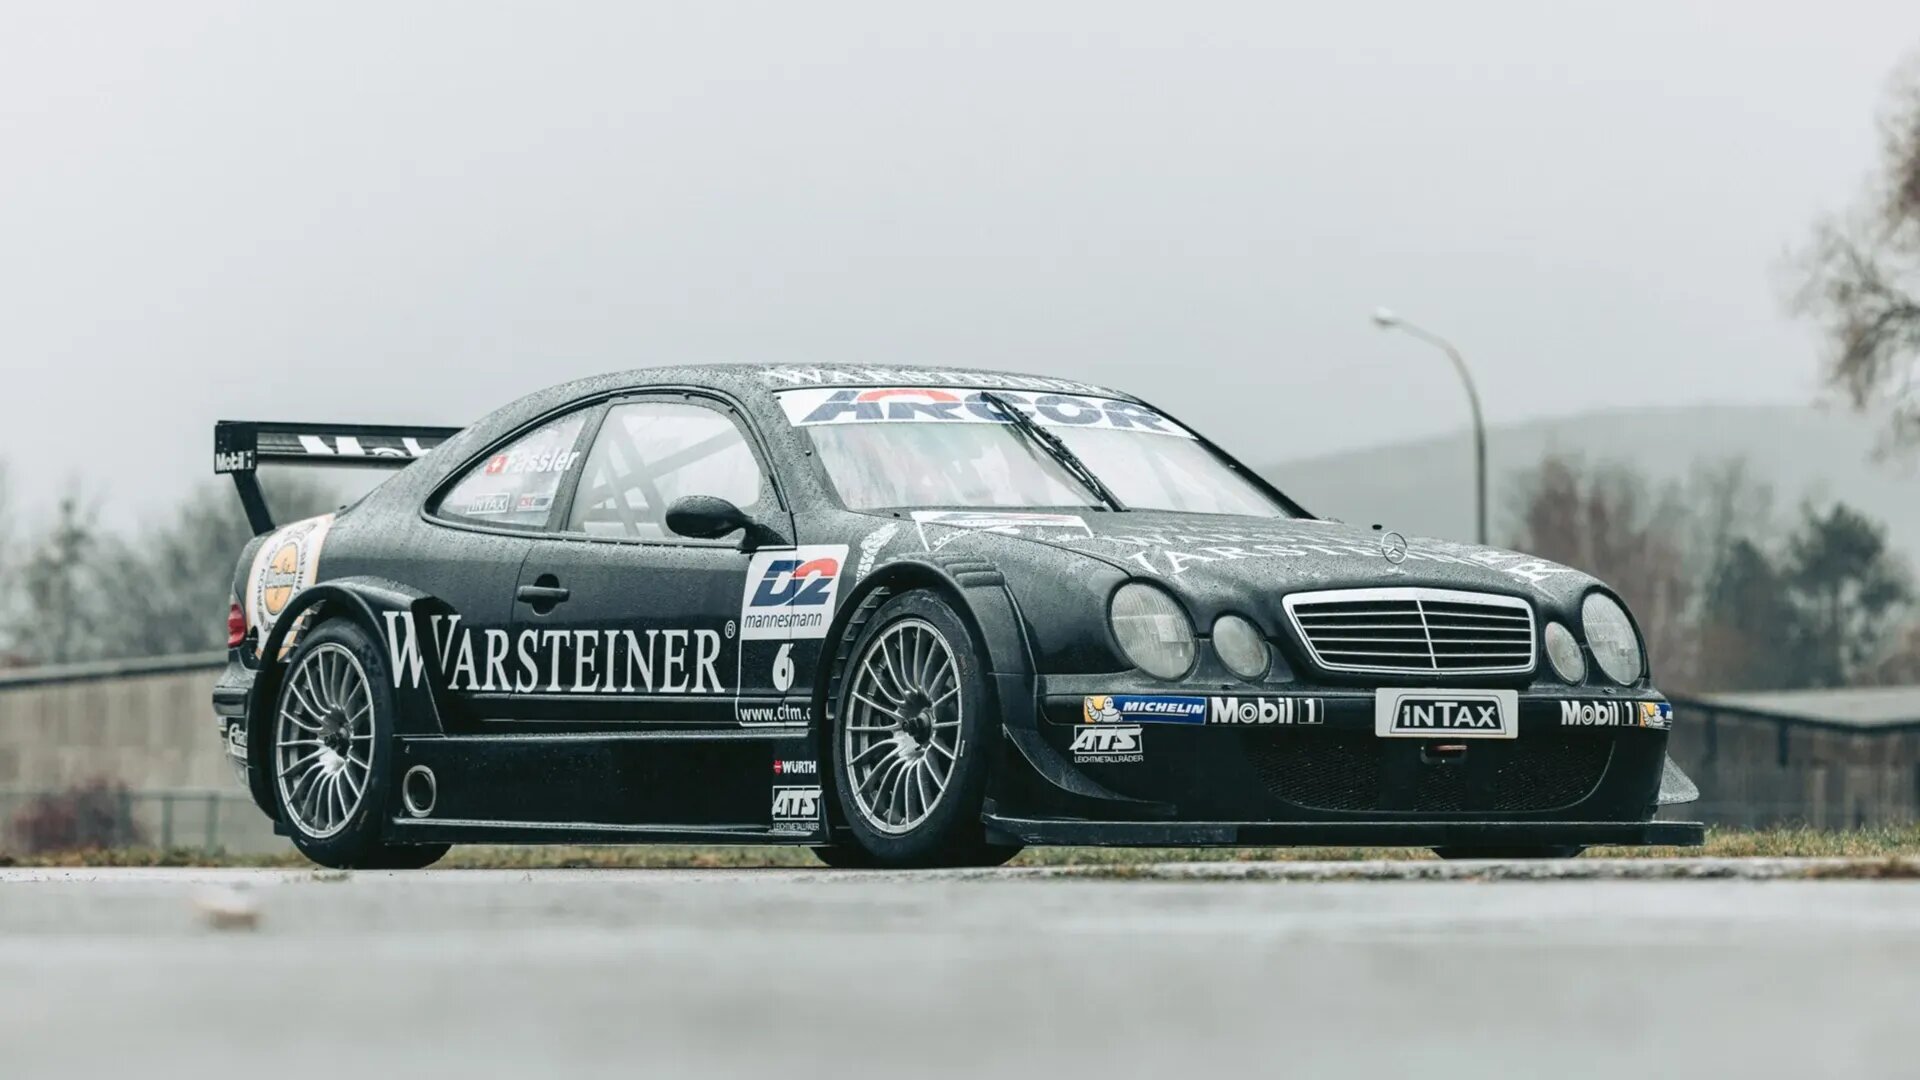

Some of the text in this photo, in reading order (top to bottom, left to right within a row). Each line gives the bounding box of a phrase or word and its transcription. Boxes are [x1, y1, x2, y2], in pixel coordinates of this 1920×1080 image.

[800, 388, 1175, 432] ARCOR
[216, 451, 244, 471] Mobil
[750, 559, 838, 607] D2
[744, 612, 822, 629] mannesmann
[772, 643, 795, 692] 6
[1122, 701, 1204, 714] MICHELIN
[1211, 697, 1316, 724] Mobil 1
[1403, 702, 1496, 728] INTAX
[1560, 701, 1619, 726] Mobil
[1069, 727, 1143, 750] ATS
[771, 789, 823, 816] ATS
